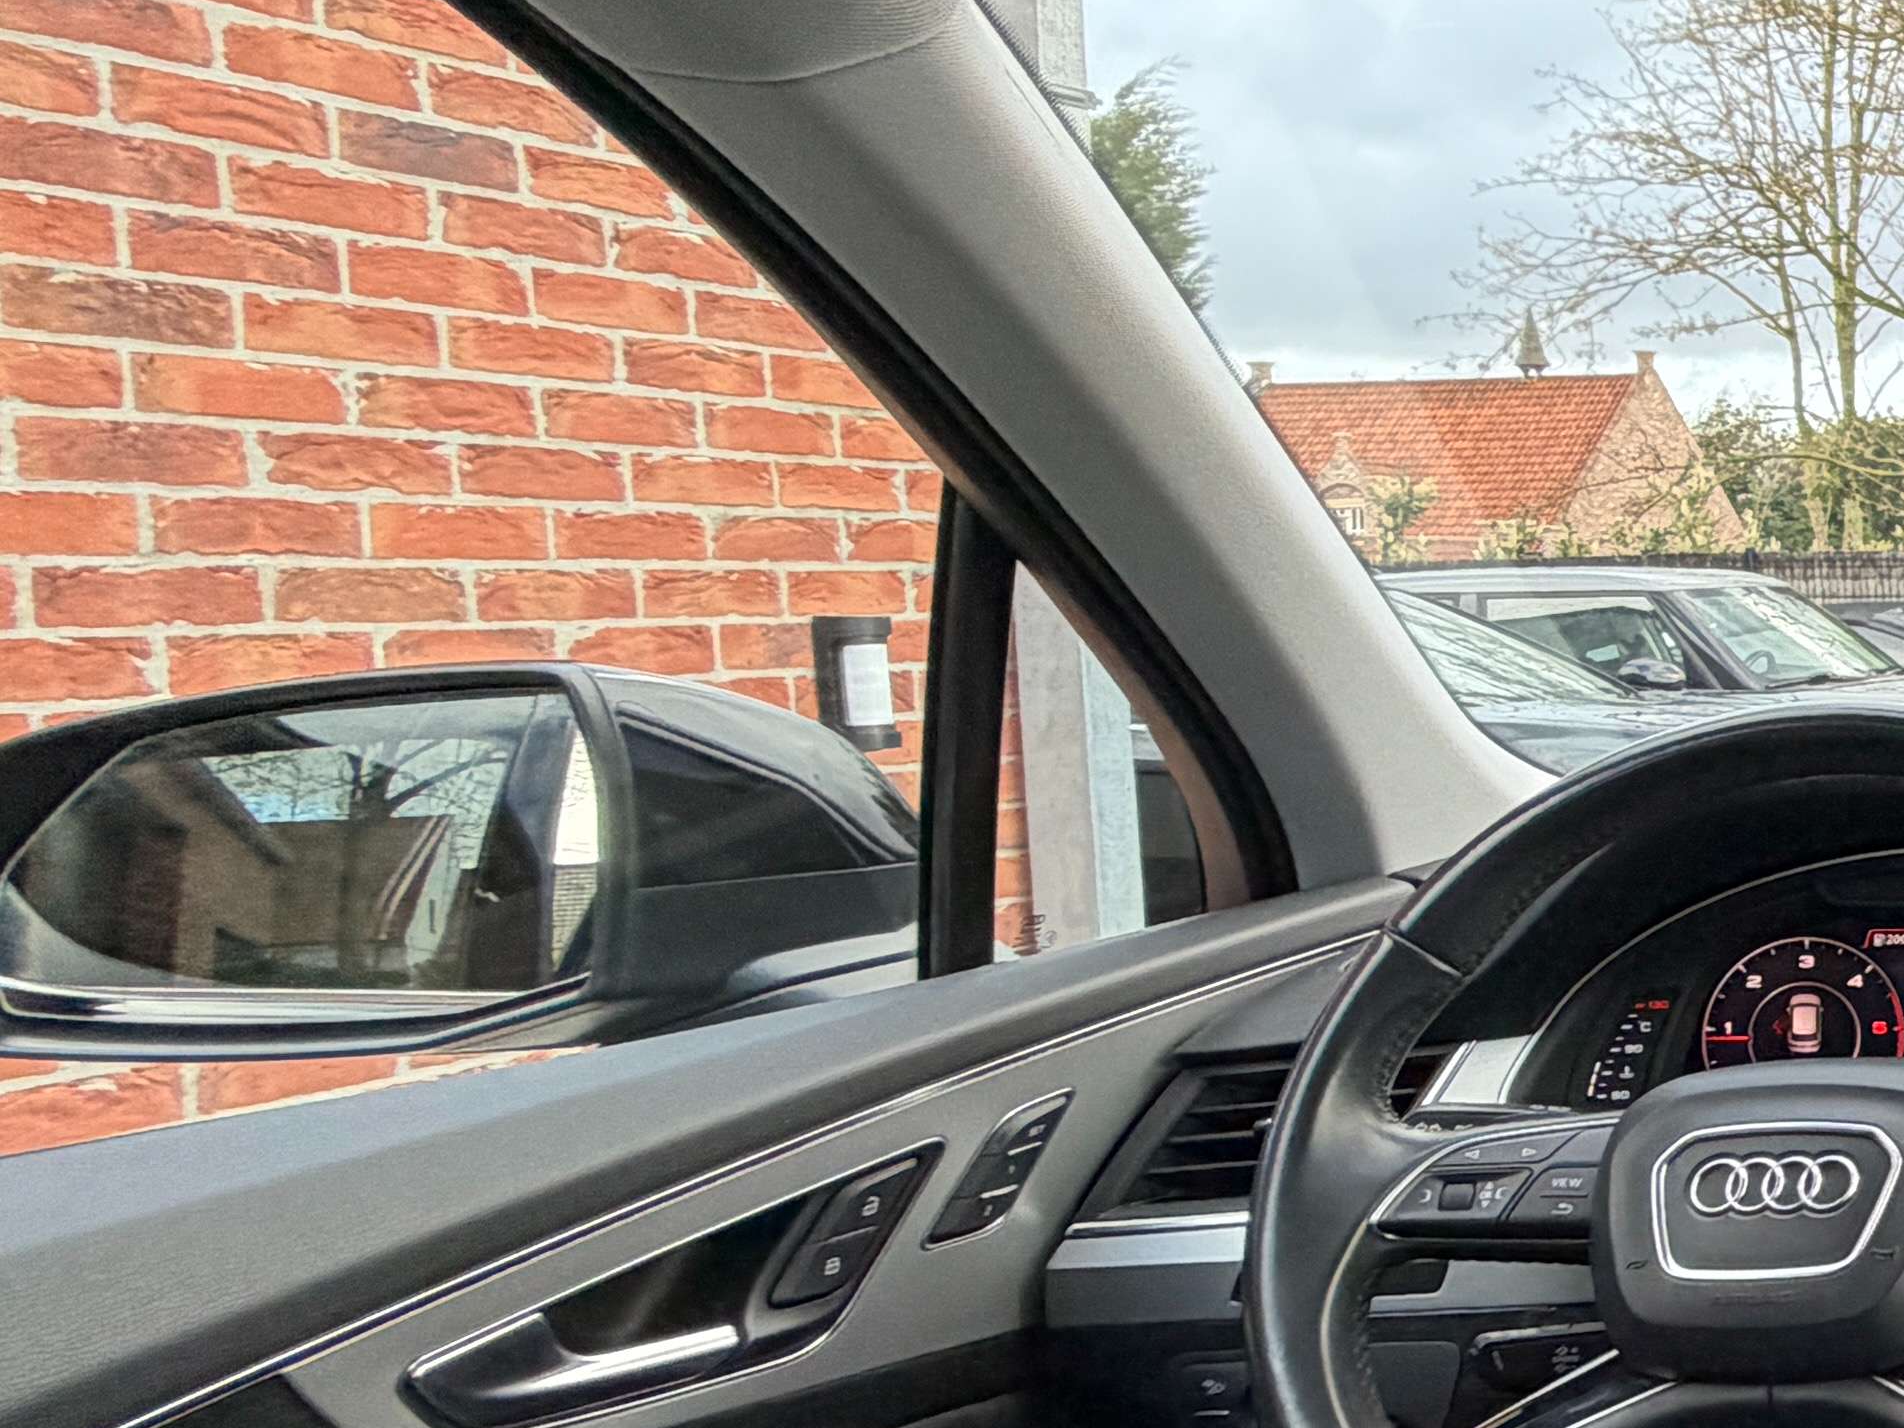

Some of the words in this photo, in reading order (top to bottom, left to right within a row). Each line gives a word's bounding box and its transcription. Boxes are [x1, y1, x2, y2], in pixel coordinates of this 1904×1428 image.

[1798, 954, 1816, 969] 3
[1745, 974, 1763, 989] 2
[1846, 974, 1863, 988] 4
[1723, 1021, 1733, 1035] 1
